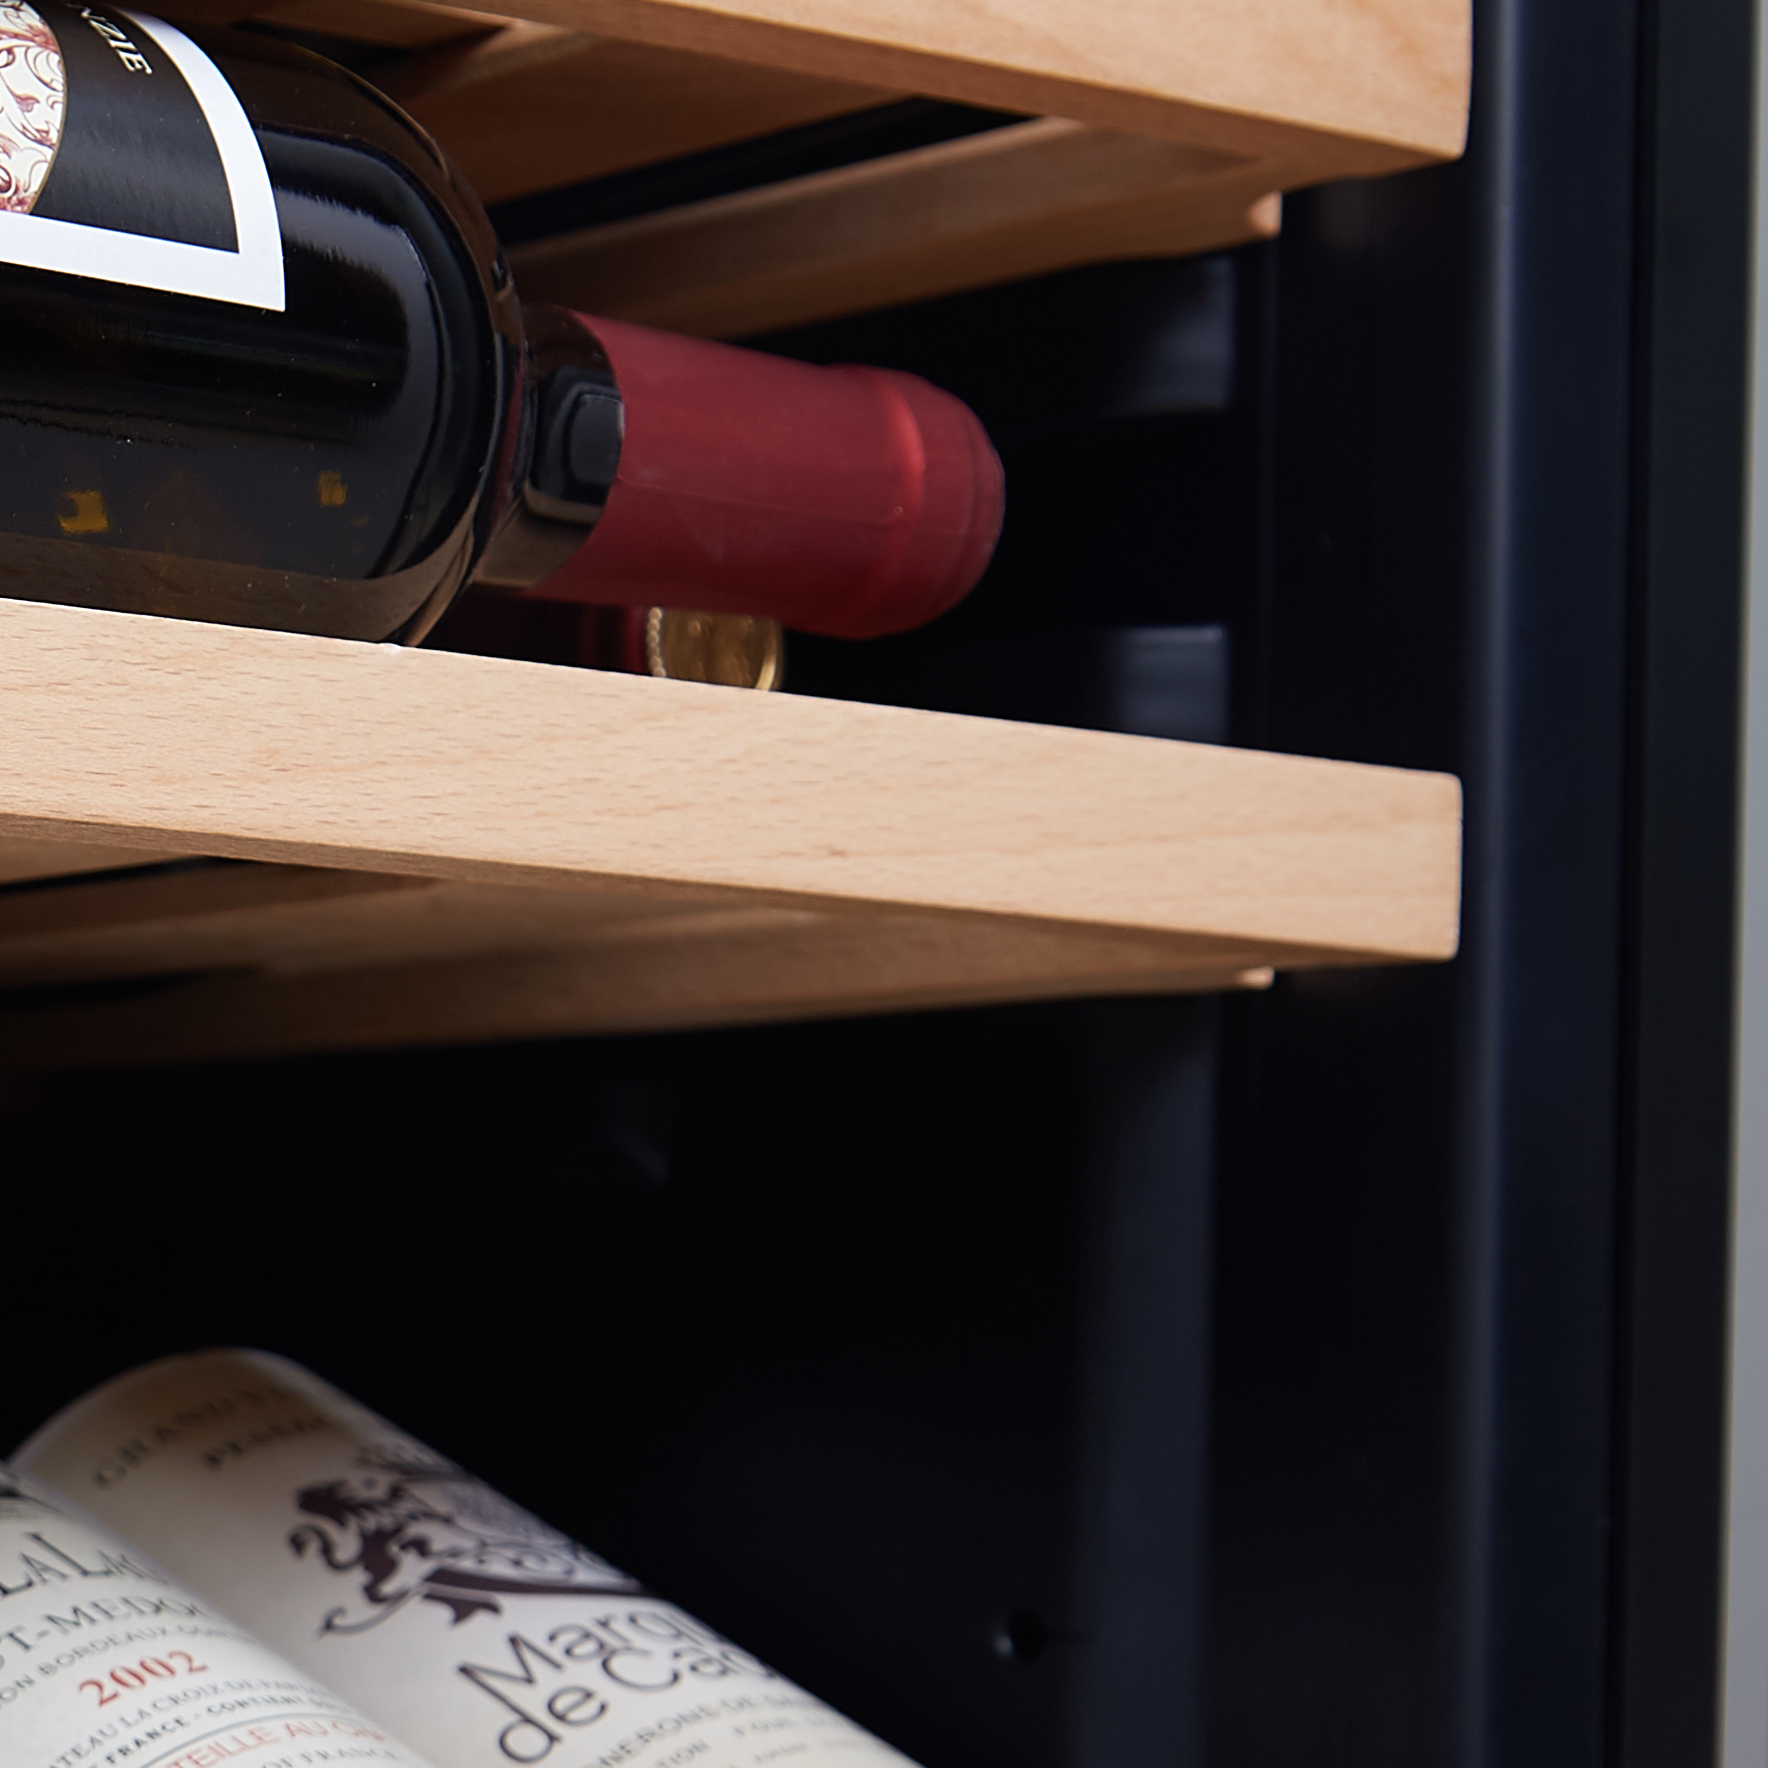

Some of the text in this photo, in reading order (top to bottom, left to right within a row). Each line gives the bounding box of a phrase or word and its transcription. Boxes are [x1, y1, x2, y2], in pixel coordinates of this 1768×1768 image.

[78, 1648, 210, 1709] 2002
[105, 1717, 187, 1768] FRANCE
[497, 1684, 611, 1765] de
